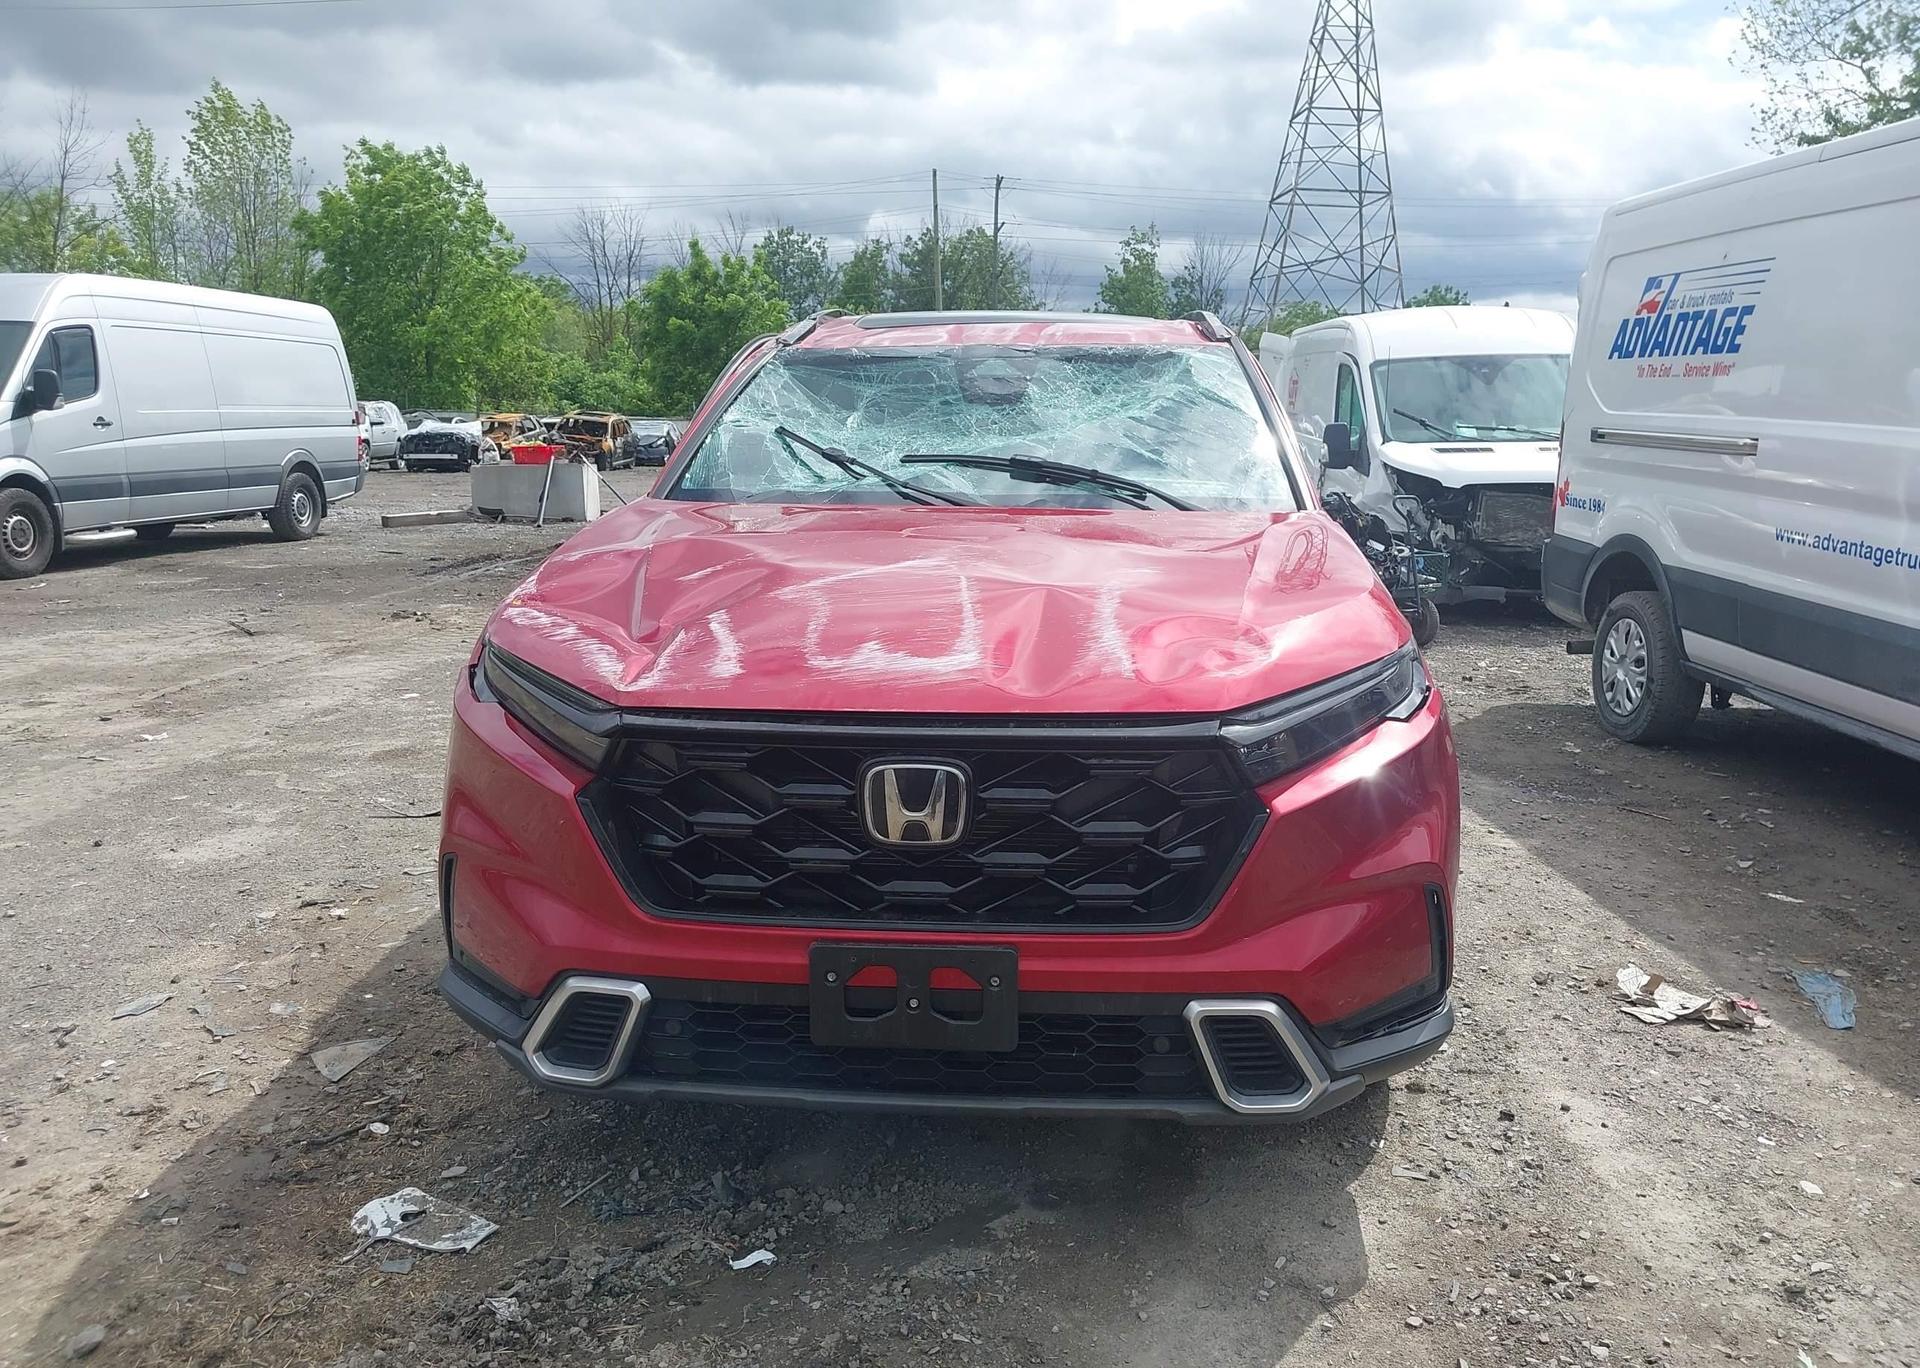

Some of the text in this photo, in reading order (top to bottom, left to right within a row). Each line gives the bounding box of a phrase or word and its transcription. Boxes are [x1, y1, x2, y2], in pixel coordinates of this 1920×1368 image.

[1667, 288, 1735, 311] car & truck rentals
[1608, 305, 1756, 360] ADVANTAGE
[1645, 363, 1659, 378] The
[1682, 362, 1711, 378] Service
[1565, 493, 1587, 510] Since
[1775, 527, 1920, 570] www.advantagetru
